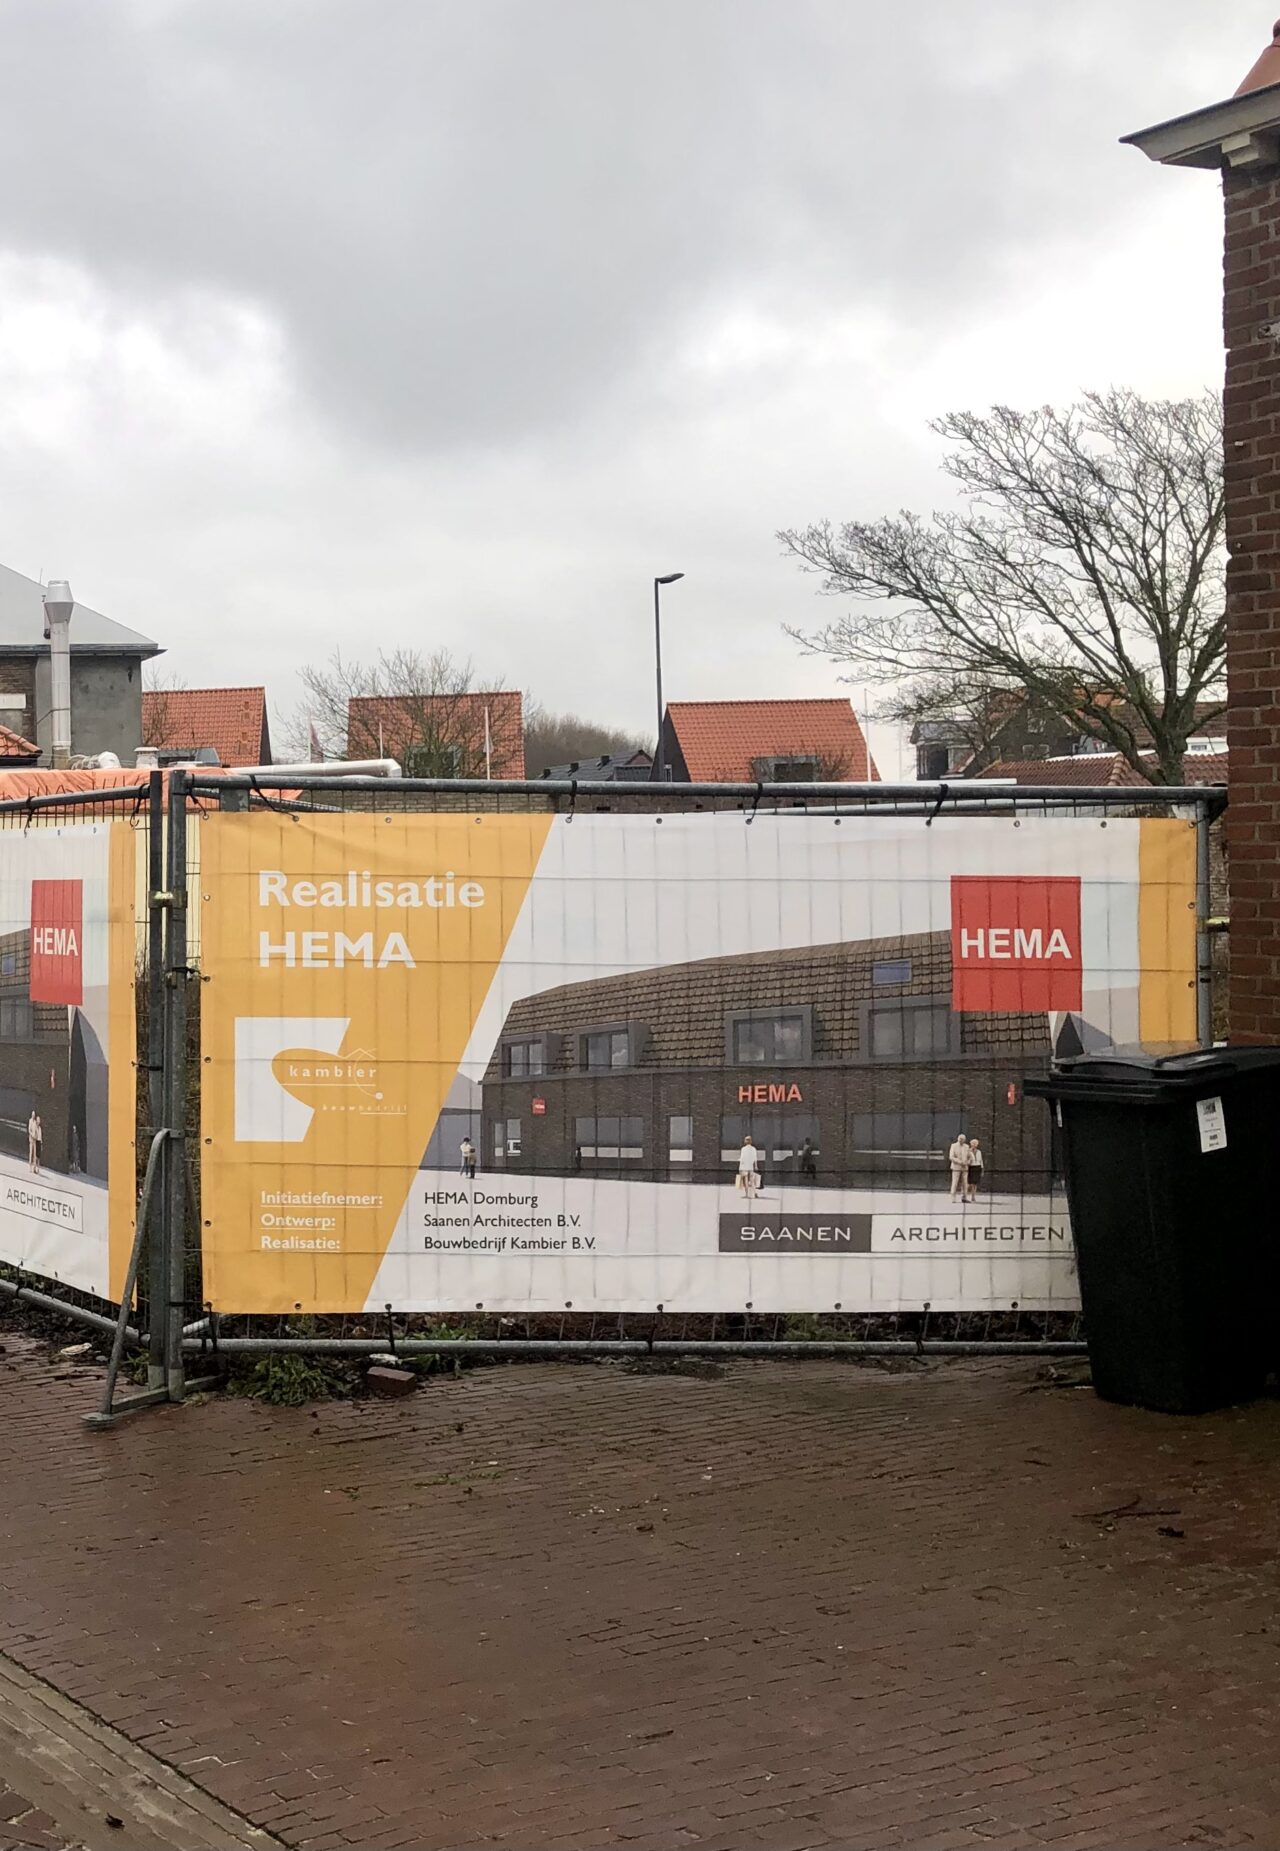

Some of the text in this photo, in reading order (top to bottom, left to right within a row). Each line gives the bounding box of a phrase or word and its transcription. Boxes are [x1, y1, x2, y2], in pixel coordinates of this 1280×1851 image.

[258, 870, 486, 909] Realisatie
[33, 927, 79, 957] HEMA
[258, 930, 417, 969] HEMA
[959, 927, 1073, 960] HEMA
[288, 1064, 377, 1078] kambier
[737, 1083, 803, 1104] HEMA
[6, 1188, 76, 1220] ARCHITECTEN
[260, 1190, 384, 1206] Initiatiefnemer:
[424, 1191, 539, 1208] HEMA Domburg
[260, 1213, 337, 1229] Ontwerp:
[423, 1214, 582, 1228] Saanen Architecten B.V.
[260, 1235, 341, 1250] Realisatie:
[739, 1226, 852, 1242] SAANEN
[889, 1226, 1065, 1242] ARCHITECTEN
[423, 1236, 597, 1253] Bouwbedrijf Kambier B.V.
